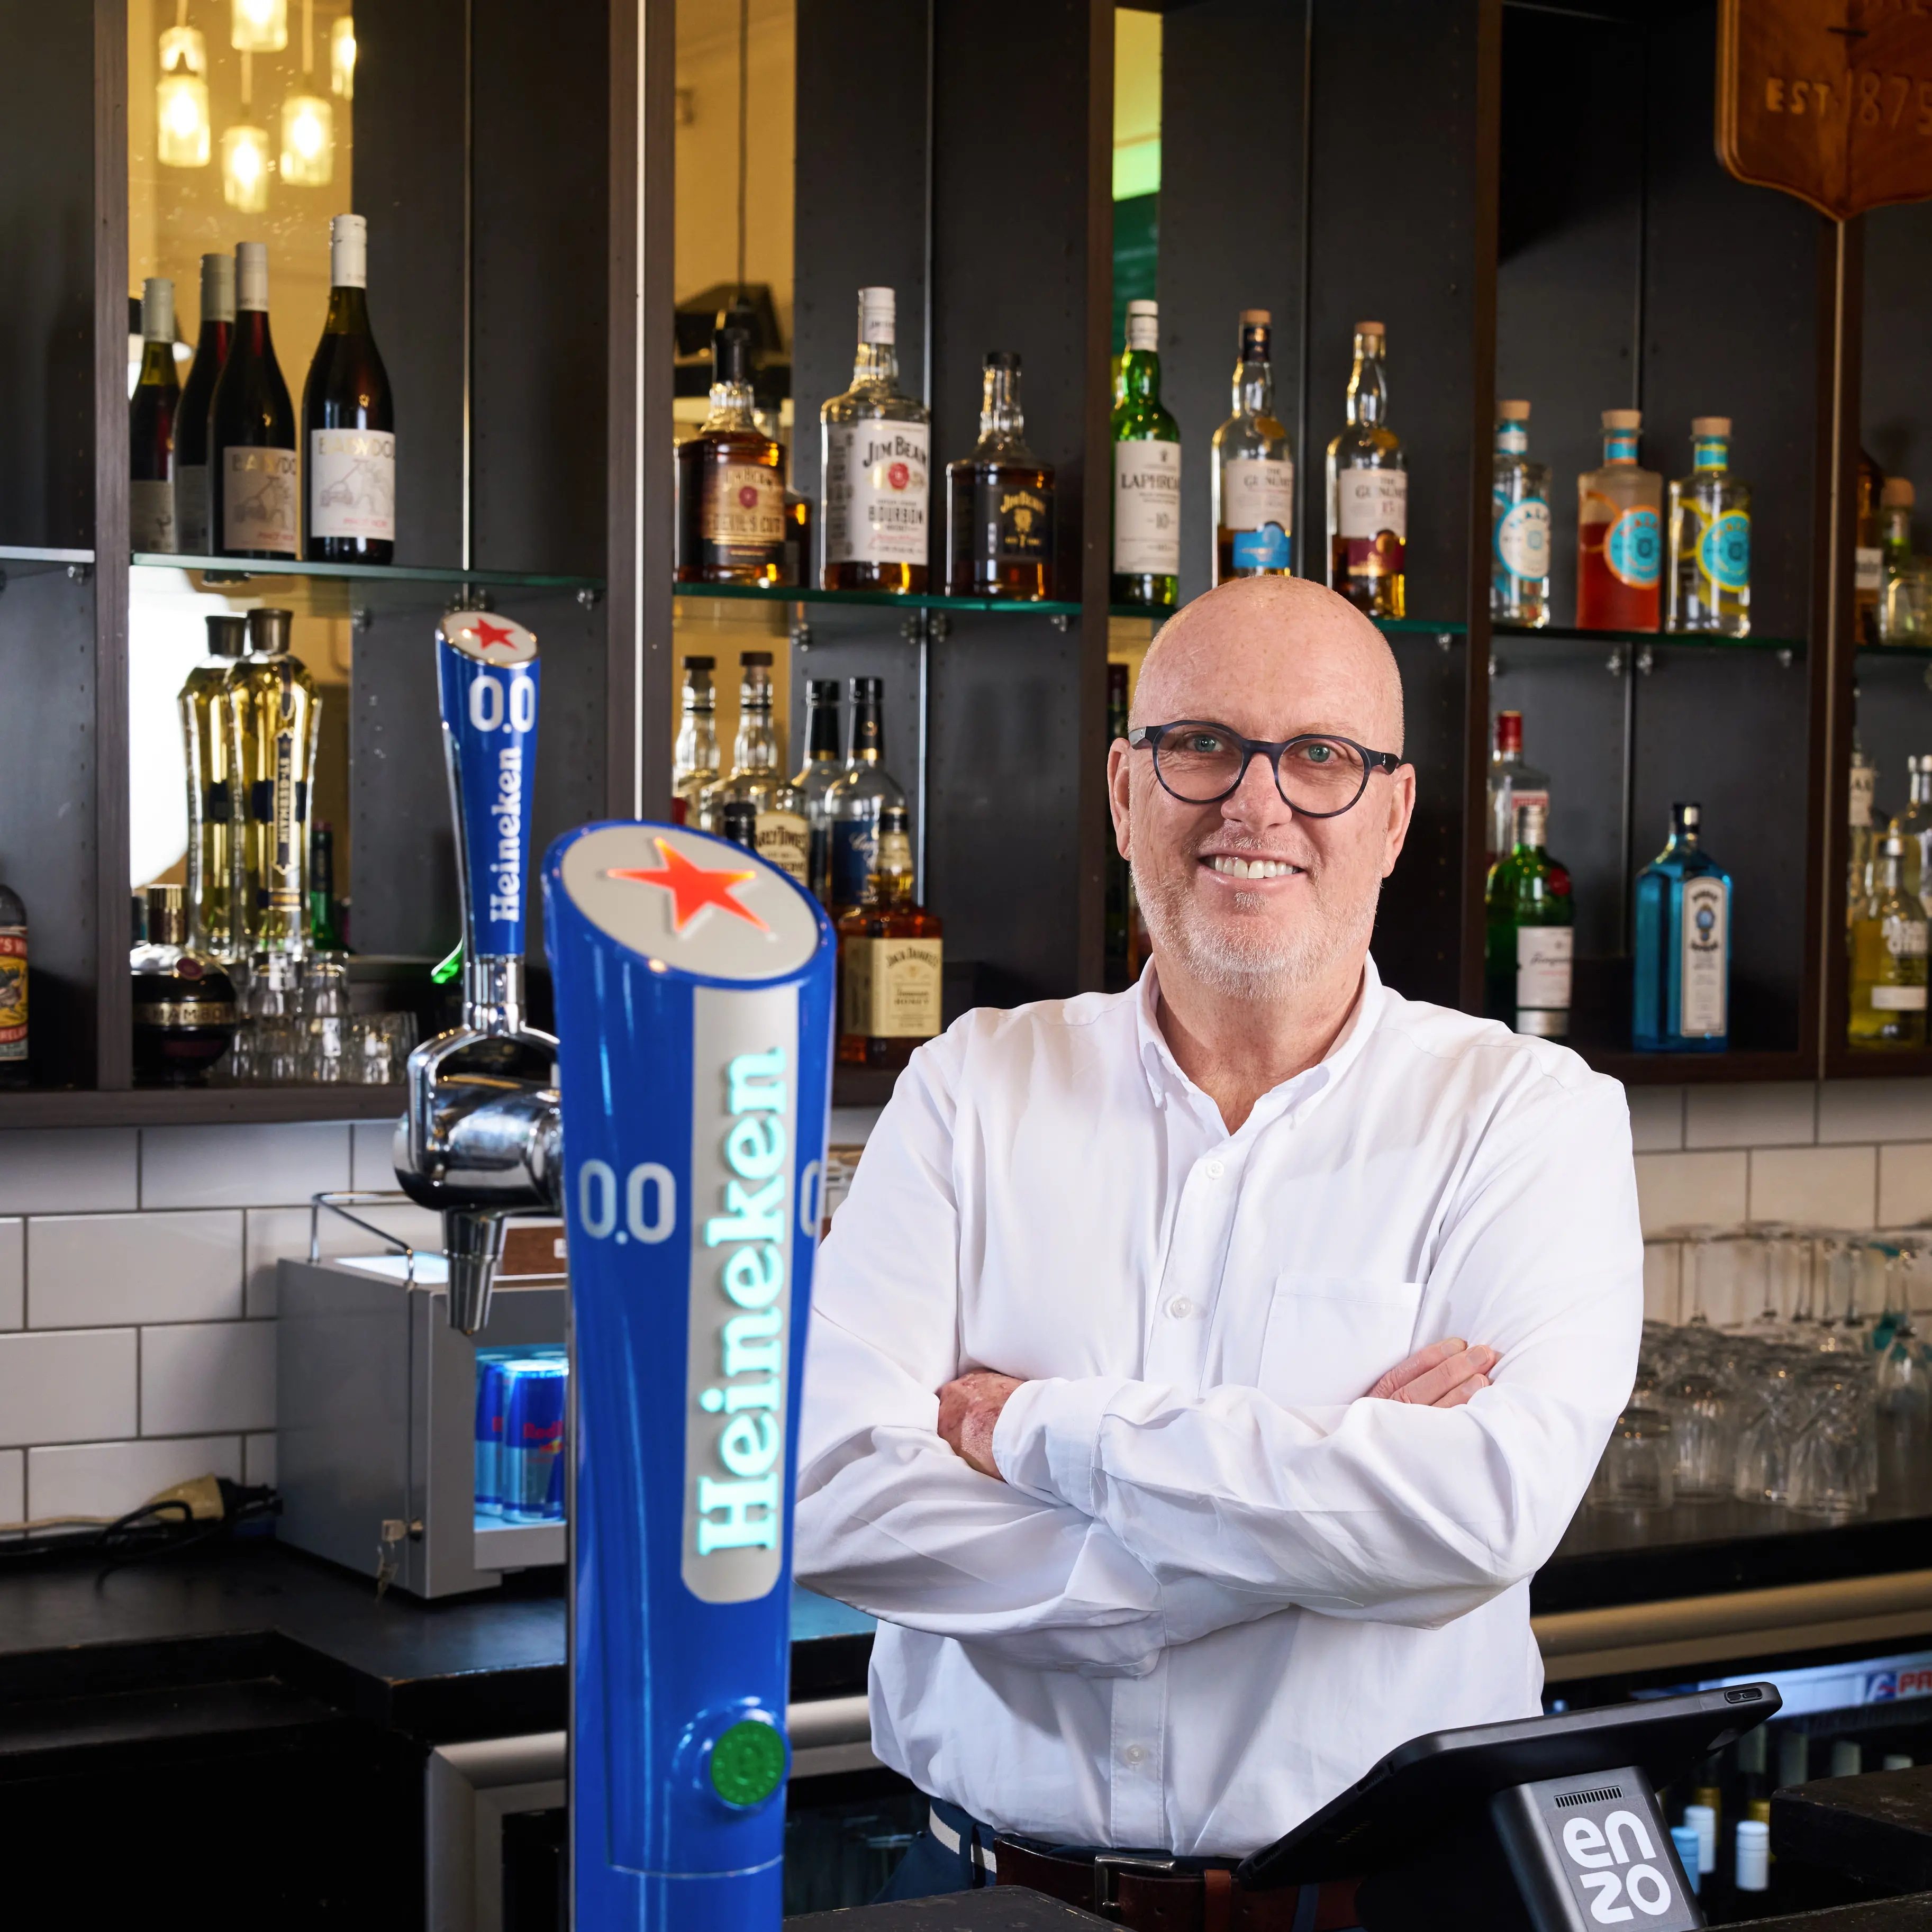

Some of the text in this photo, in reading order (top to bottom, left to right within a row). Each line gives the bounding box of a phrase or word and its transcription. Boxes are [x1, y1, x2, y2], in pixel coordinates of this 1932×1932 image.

[1765, 77, 1831, 116] EST
[469, 674, 536, 734] 0.0
[489, 746, 522, 923] Heineken
[578, 1158, 677, 1244] 0.0
[696, 1046, 787, 1556] Heineken
